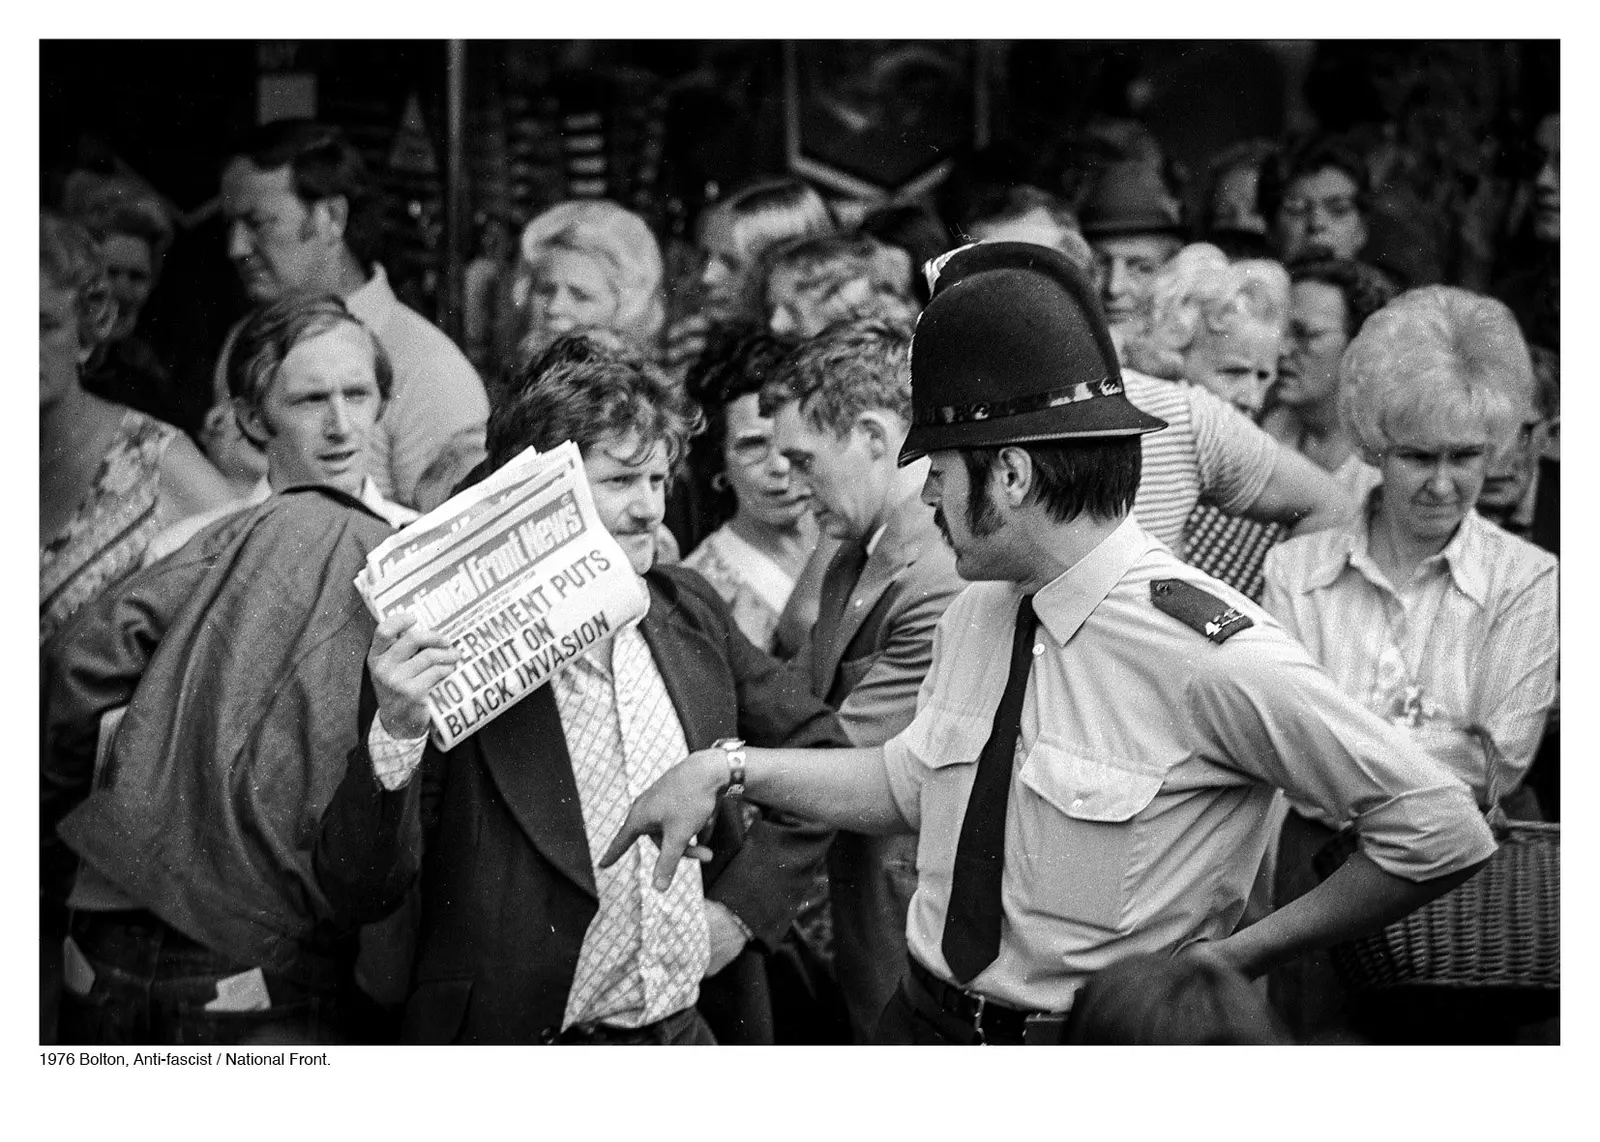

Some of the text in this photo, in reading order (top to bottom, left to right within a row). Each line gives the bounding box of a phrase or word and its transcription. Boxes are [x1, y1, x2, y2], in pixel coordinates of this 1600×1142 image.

[384, 562, 480, 632] tional
[466, 531, 530, 596] Front
[518, 503, 584, 561] News
[451, 584, 552, 665] ERNMENT
[550, 549, 611, 599] PUTS
[428, 618, 556, 716] NO LIMIT ON
[444, 610, 610, 738] BLACK INVASION
